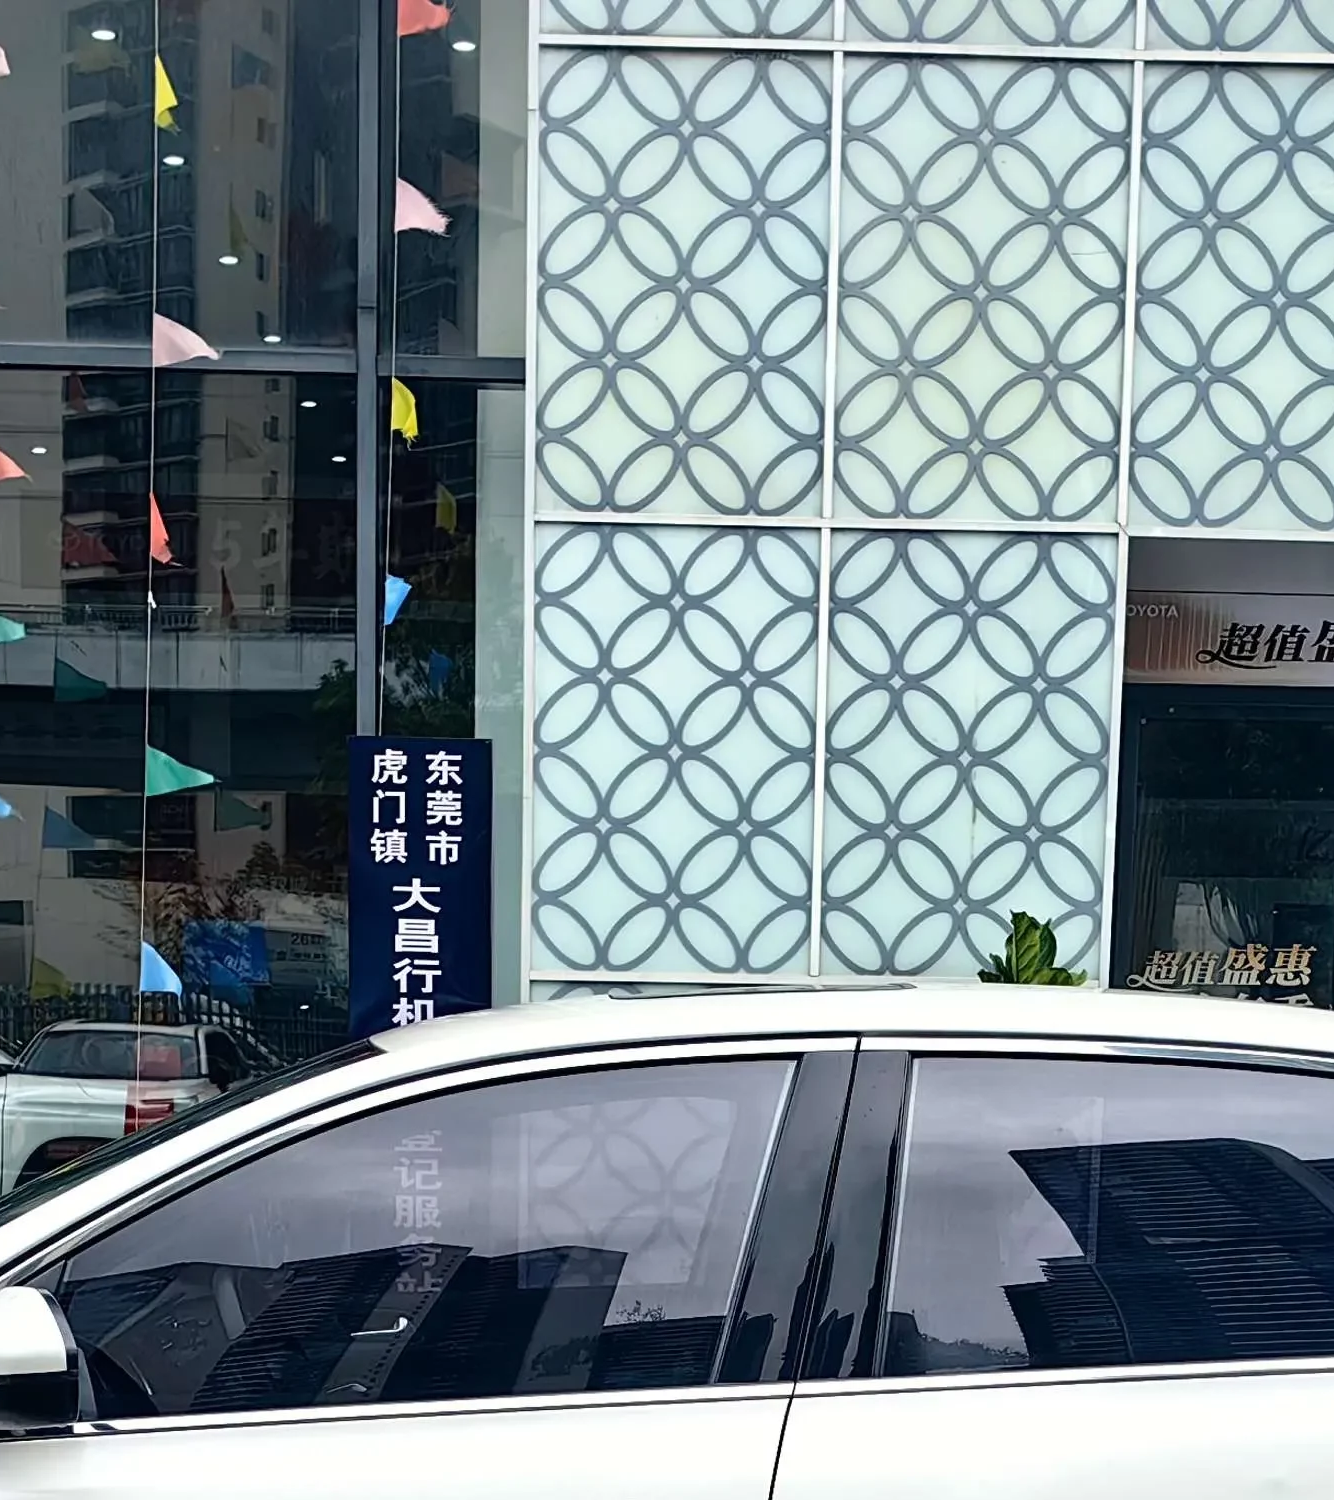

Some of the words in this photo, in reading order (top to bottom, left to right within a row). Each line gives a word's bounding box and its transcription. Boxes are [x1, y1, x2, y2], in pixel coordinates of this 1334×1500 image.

[370, 748, 408, 864] 虎门镇
[425, 750, 463, 866] 东莞市
[1126, 943, 1318, 991] 超值盛惠
